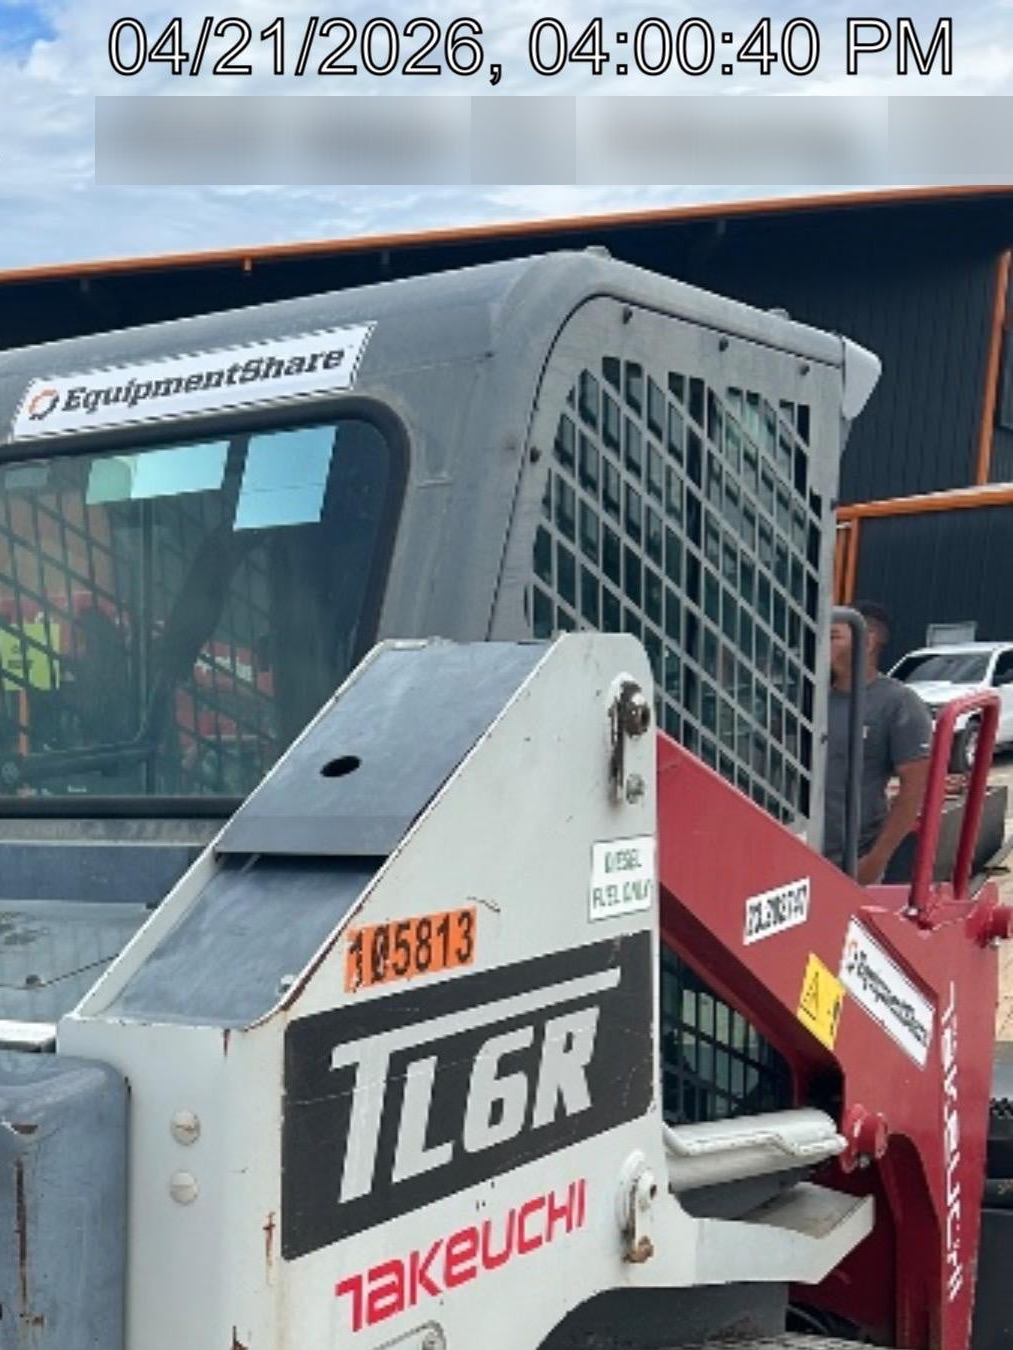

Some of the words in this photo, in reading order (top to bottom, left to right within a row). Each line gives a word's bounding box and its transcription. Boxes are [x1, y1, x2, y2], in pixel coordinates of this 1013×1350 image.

[61, 348, 345, 416] EquipmentShare
[348, 911, 474, 992] 105813
[329, 966, 621, 1204] TL6R
